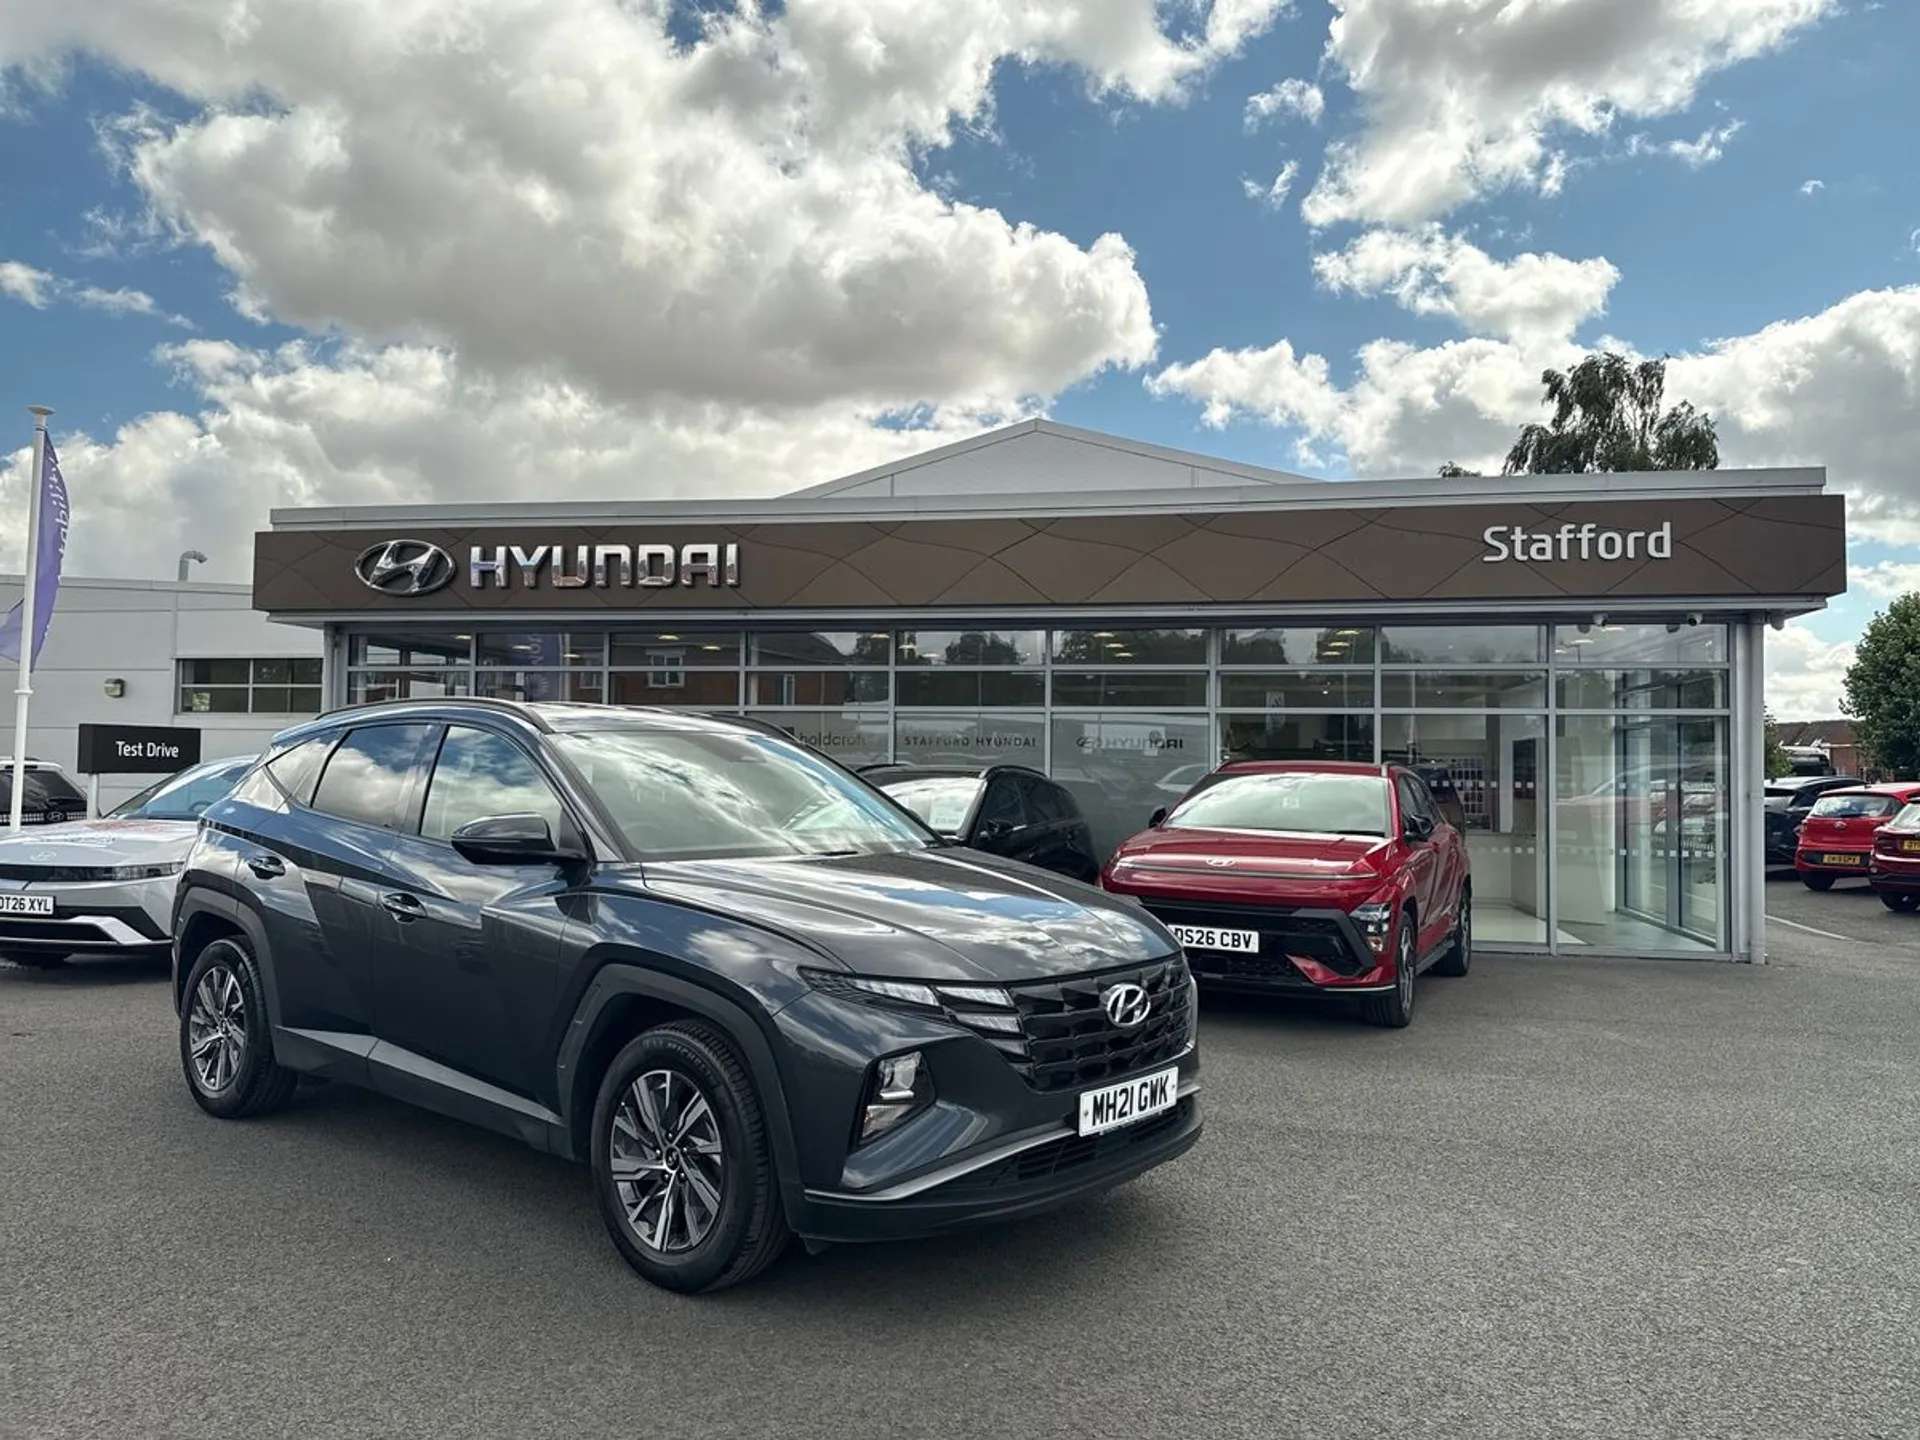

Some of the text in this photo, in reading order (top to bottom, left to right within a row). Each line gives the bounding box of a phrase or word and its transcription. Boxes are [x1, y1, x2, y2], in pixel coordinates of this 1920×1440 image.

[1482, 521, 1672, 562] Stafford
[469, 543, 740, 589] HYUNDAI
[115, 741, 179, 758] Test Drive
[904, 735, 1037, 748] STAFFORD HYUNDAI
[29, 898, 51, 911] XYL
[1220, 932, 1252, 949] CBV
[1092, 1074, 1169, 1126] MH21 GWK
